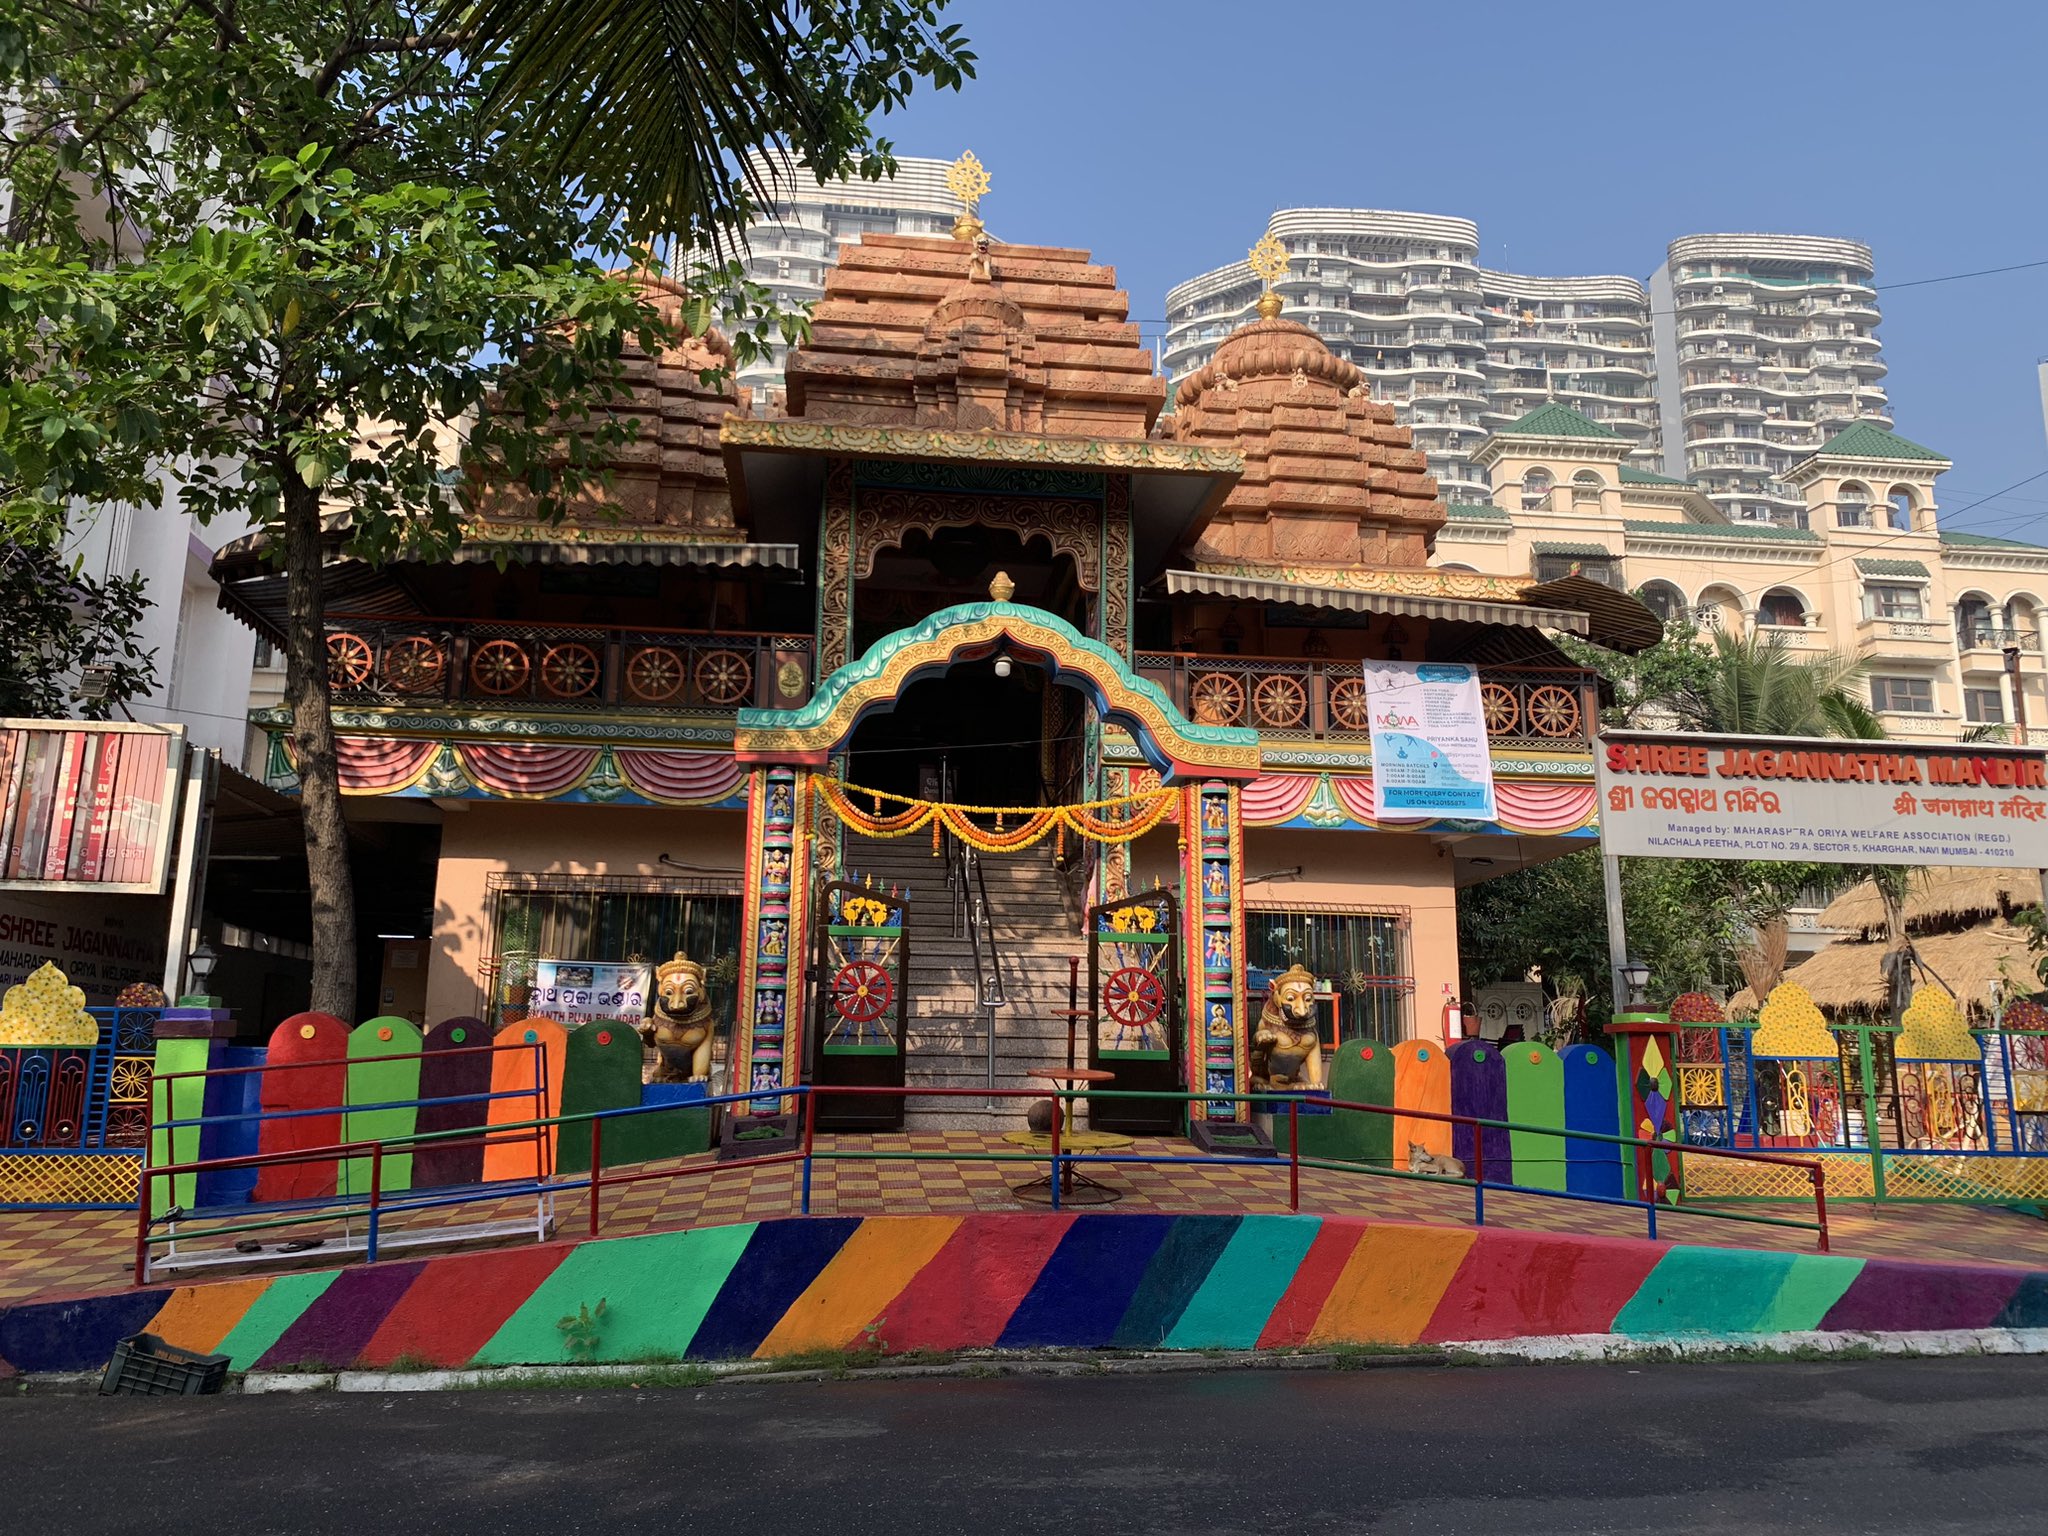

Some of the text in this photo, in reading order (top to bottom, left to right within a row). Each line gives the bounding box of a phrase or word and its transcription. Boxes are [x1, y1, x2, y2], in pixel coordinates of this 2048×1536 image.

[1606, 744, 2048, 788] SHREE JAGANNATHA MANDIR
[1388, 790, 1480, 798] FOR MORE QUERY CONTACT
[1607, 785, 1781, 814] ଶ୍ରୀ ଜଗନ୍ନାଥ ମନ୍ଦିର
[1893, 791, 2047, 822] श्री जगन्नाथ मंदिर
[1668, 824, 2011, 843] Managed by: MAHARASHRA ORIYA WELFARE ASSOCIATION (REGD.)
[1648, 837, 1702, 847] NILACHALA
[1745, 840, 1769, 849] PLOT
[1771, 841, 1787, 850] NO.
[1790, 842, 1800, 850] 29
[1813, 843, 1850, 852] SECTOR
[1941, 847, 1978, 855] MUMBAI
[1985, 848, 2014, 857] 410210
[0, 914, 57, 947] SHREE
[562, 989, 592, 1008] ପୂଜା
[568, 1012, 592, 1023] PUJA
